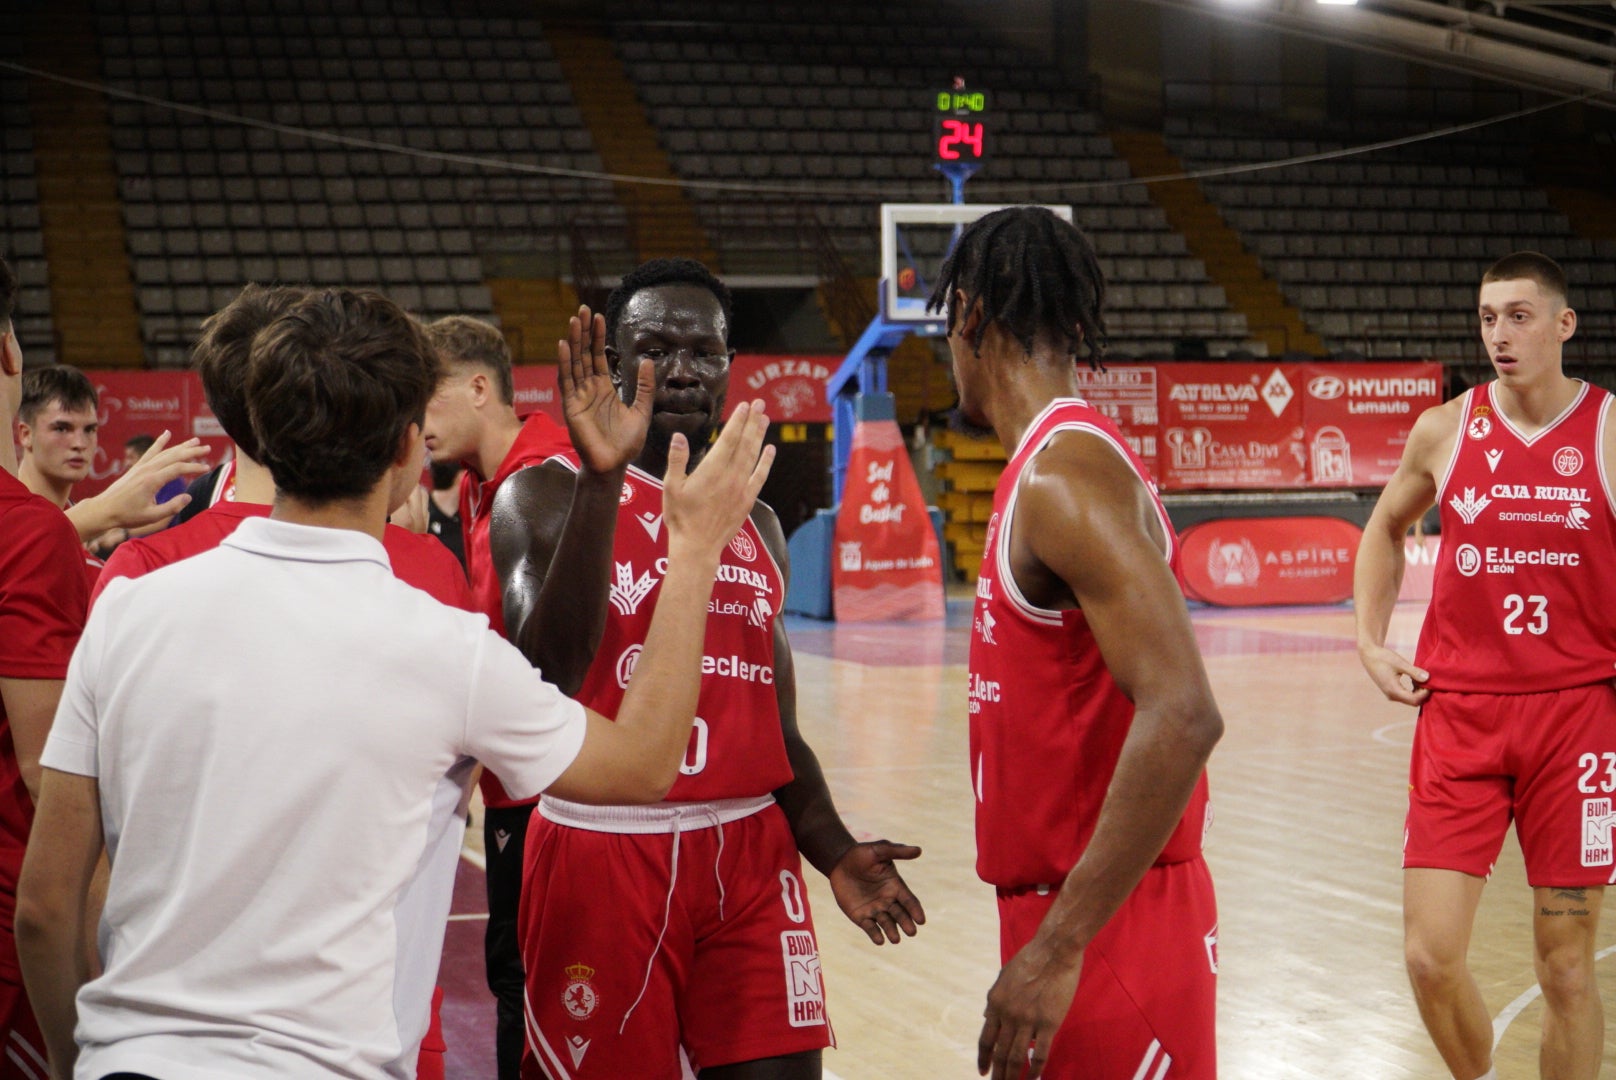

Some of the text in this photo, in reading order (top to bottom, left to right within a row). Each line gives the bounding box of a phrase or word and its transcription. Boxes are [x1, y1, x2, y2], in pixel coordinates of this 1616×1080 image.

[939, 119, 983, 159] 24
[747, 359, 832, 389] URZAP
[1348, 379, 1436, 396] HYUNDAI
[1348, 400, 1411, 414] Lemauto
[1491, 484, 1591, 502] CAJA RURAL
[1499, 511, 1565, 523] somosLeón
[1265, 548, 1349, 565] ASPIRE
[1486, 547, 1580, 566] E.Leclerc
[1486, 563, 1515, 574] LEÓN
[707, 598, 749, 617] sLeón
[1503, 594, 1549, 635] 23
[701, 655, 774, 685] eclerc
[1577, 752, 1616, 794] 23
[1587, 801, 1609, 817] BUN
[1585, 848, 1609, 863] HAM
[779, 868, 806, 924] 0
[786, 935, 814, 956] BUN
[794, 1001, 823, 1022] HAM
